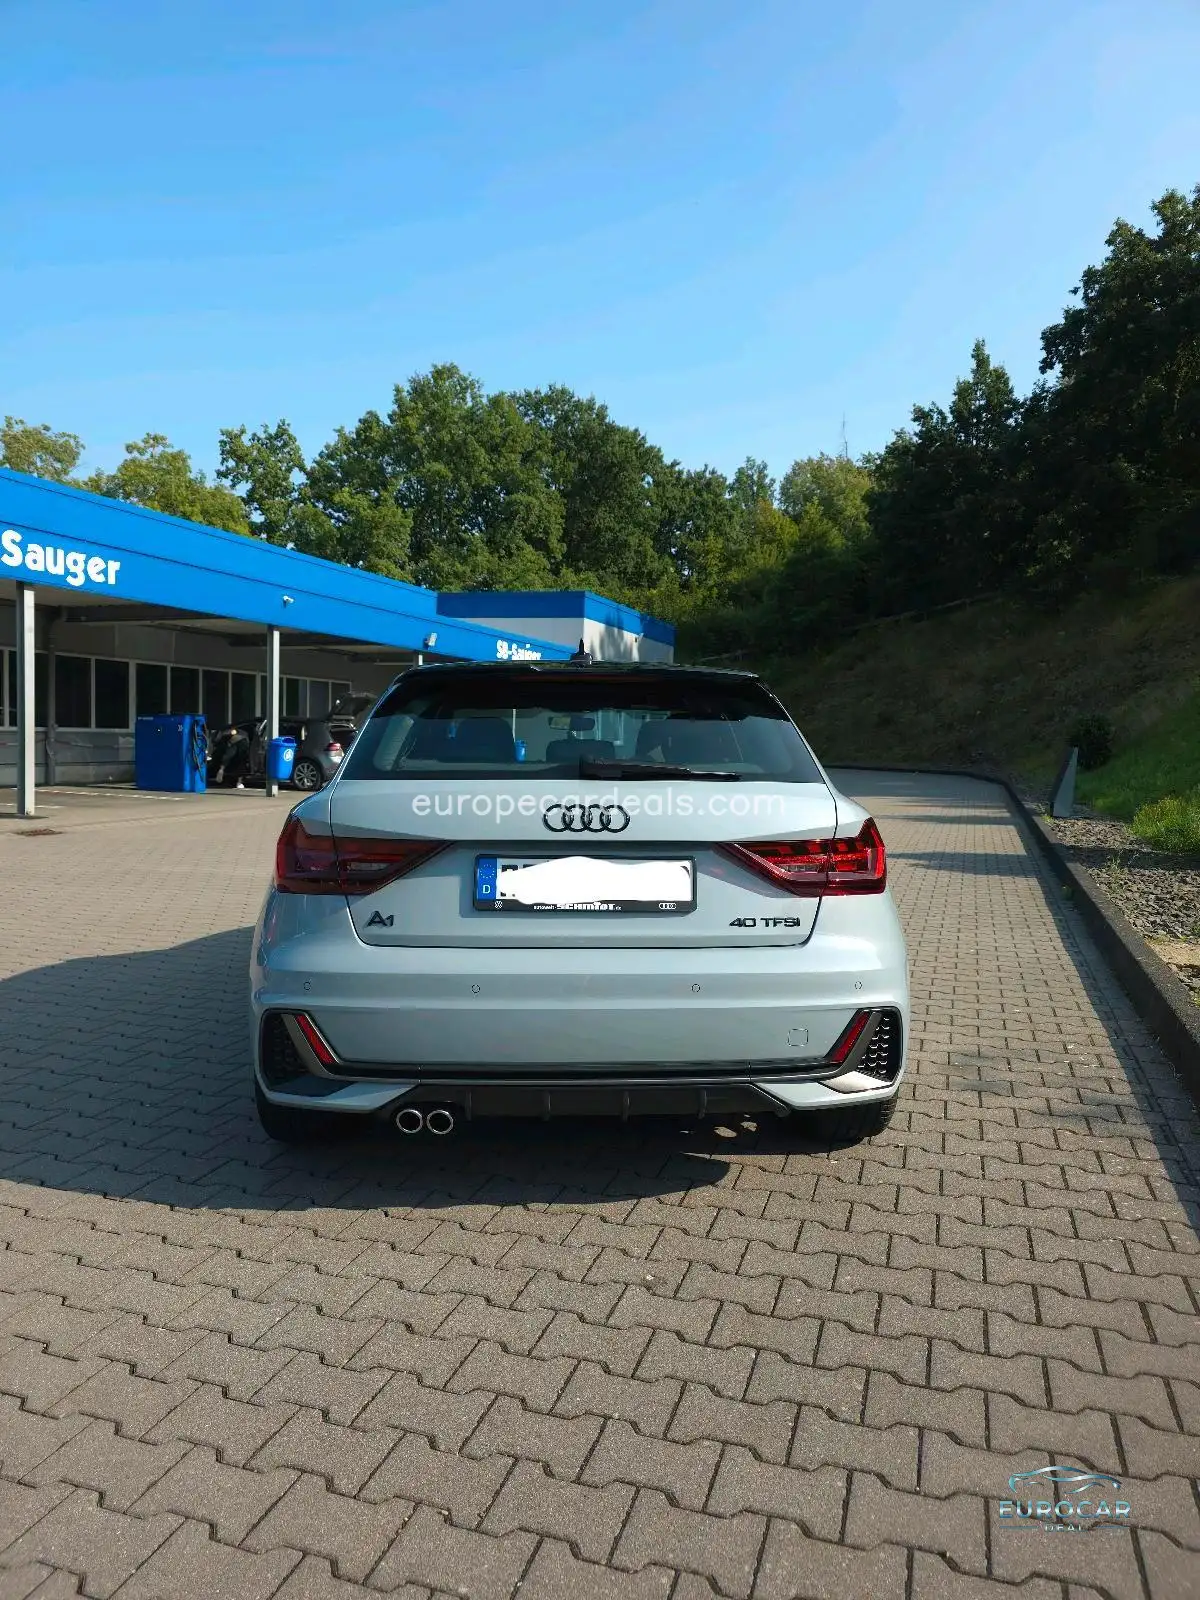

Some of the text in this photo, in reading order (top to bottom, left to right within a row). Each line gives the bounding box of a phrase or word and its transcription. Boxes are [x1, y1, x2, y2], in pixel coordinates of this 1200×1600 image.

[0, 529, 121, 586] Sauger
[366, 910, 394, 927] A1
[729, 917, 801, 928] 40 TFSI
